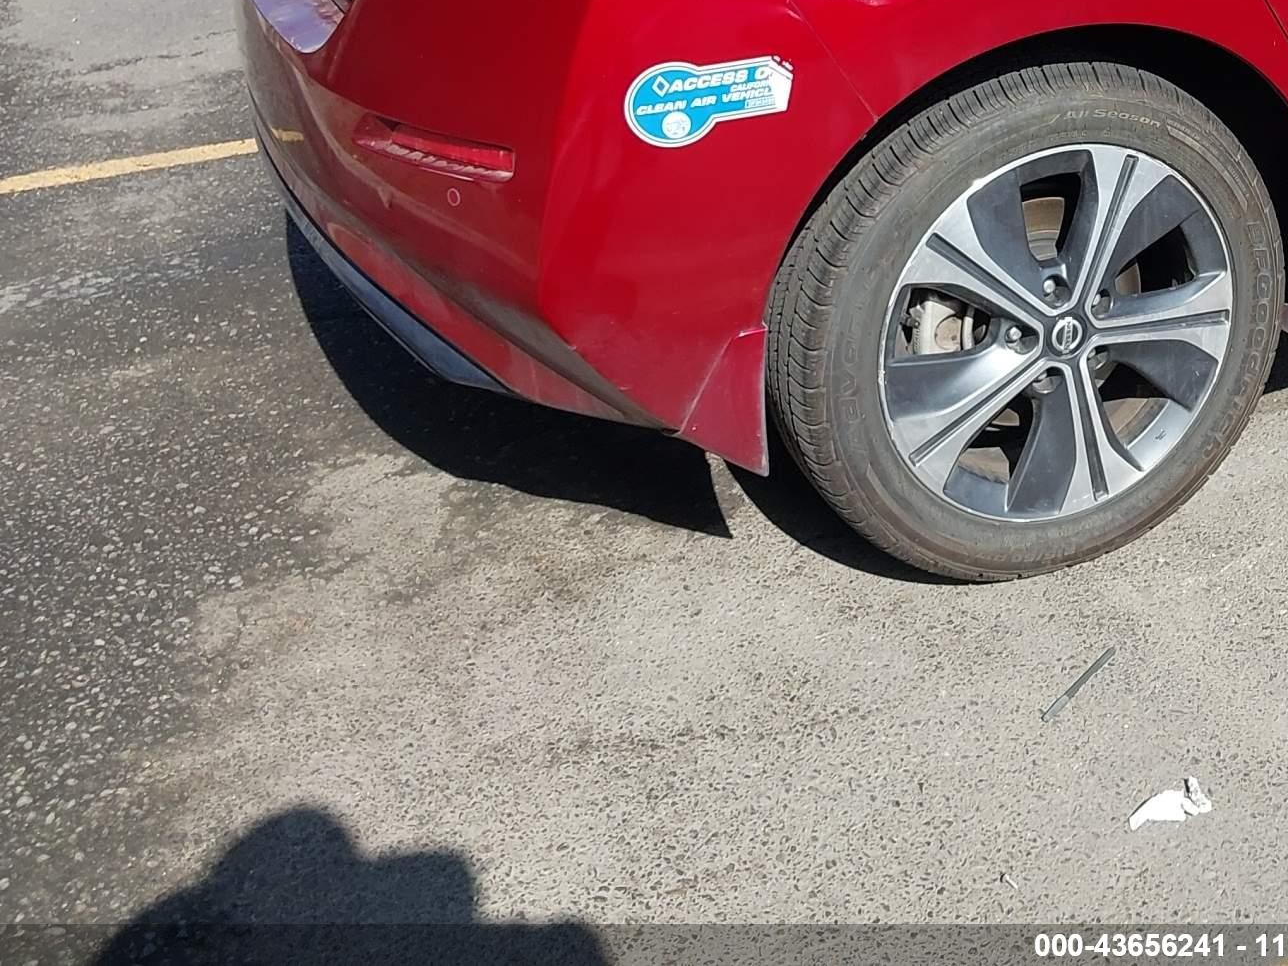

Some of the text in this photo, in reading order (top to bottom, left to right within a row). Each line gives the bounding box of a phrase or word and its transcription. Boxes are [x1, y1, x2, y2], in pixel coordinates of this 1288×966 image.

[668, 65, 774, 93] ACCESS O
[636, 99, 687, 116] CLEAN
[690, 94, 716, 108] AIR
[721, 87, 773, 103] VEHICL
[1093, 108, 1161, 128] Season
